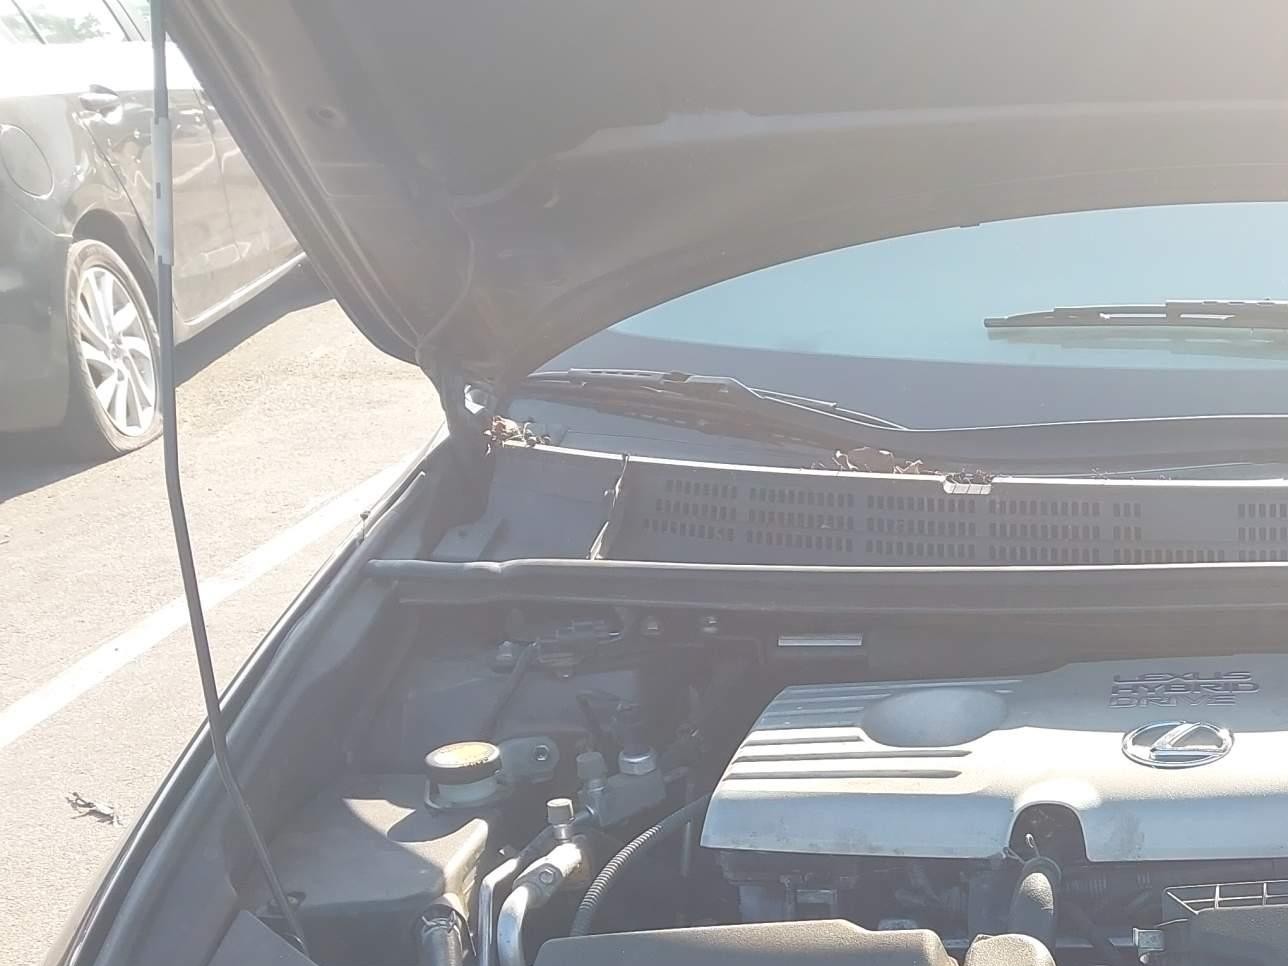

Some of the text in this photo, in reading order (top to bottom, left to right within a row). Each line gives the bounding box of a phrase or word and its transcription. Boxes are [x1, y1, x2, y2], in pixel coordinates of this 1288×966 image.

[1113, 671, 1252, 685] LEXUS
[1111, 683, 1261, 696] HYBRID
[1108, 695, 1237, 708] DRIVE
